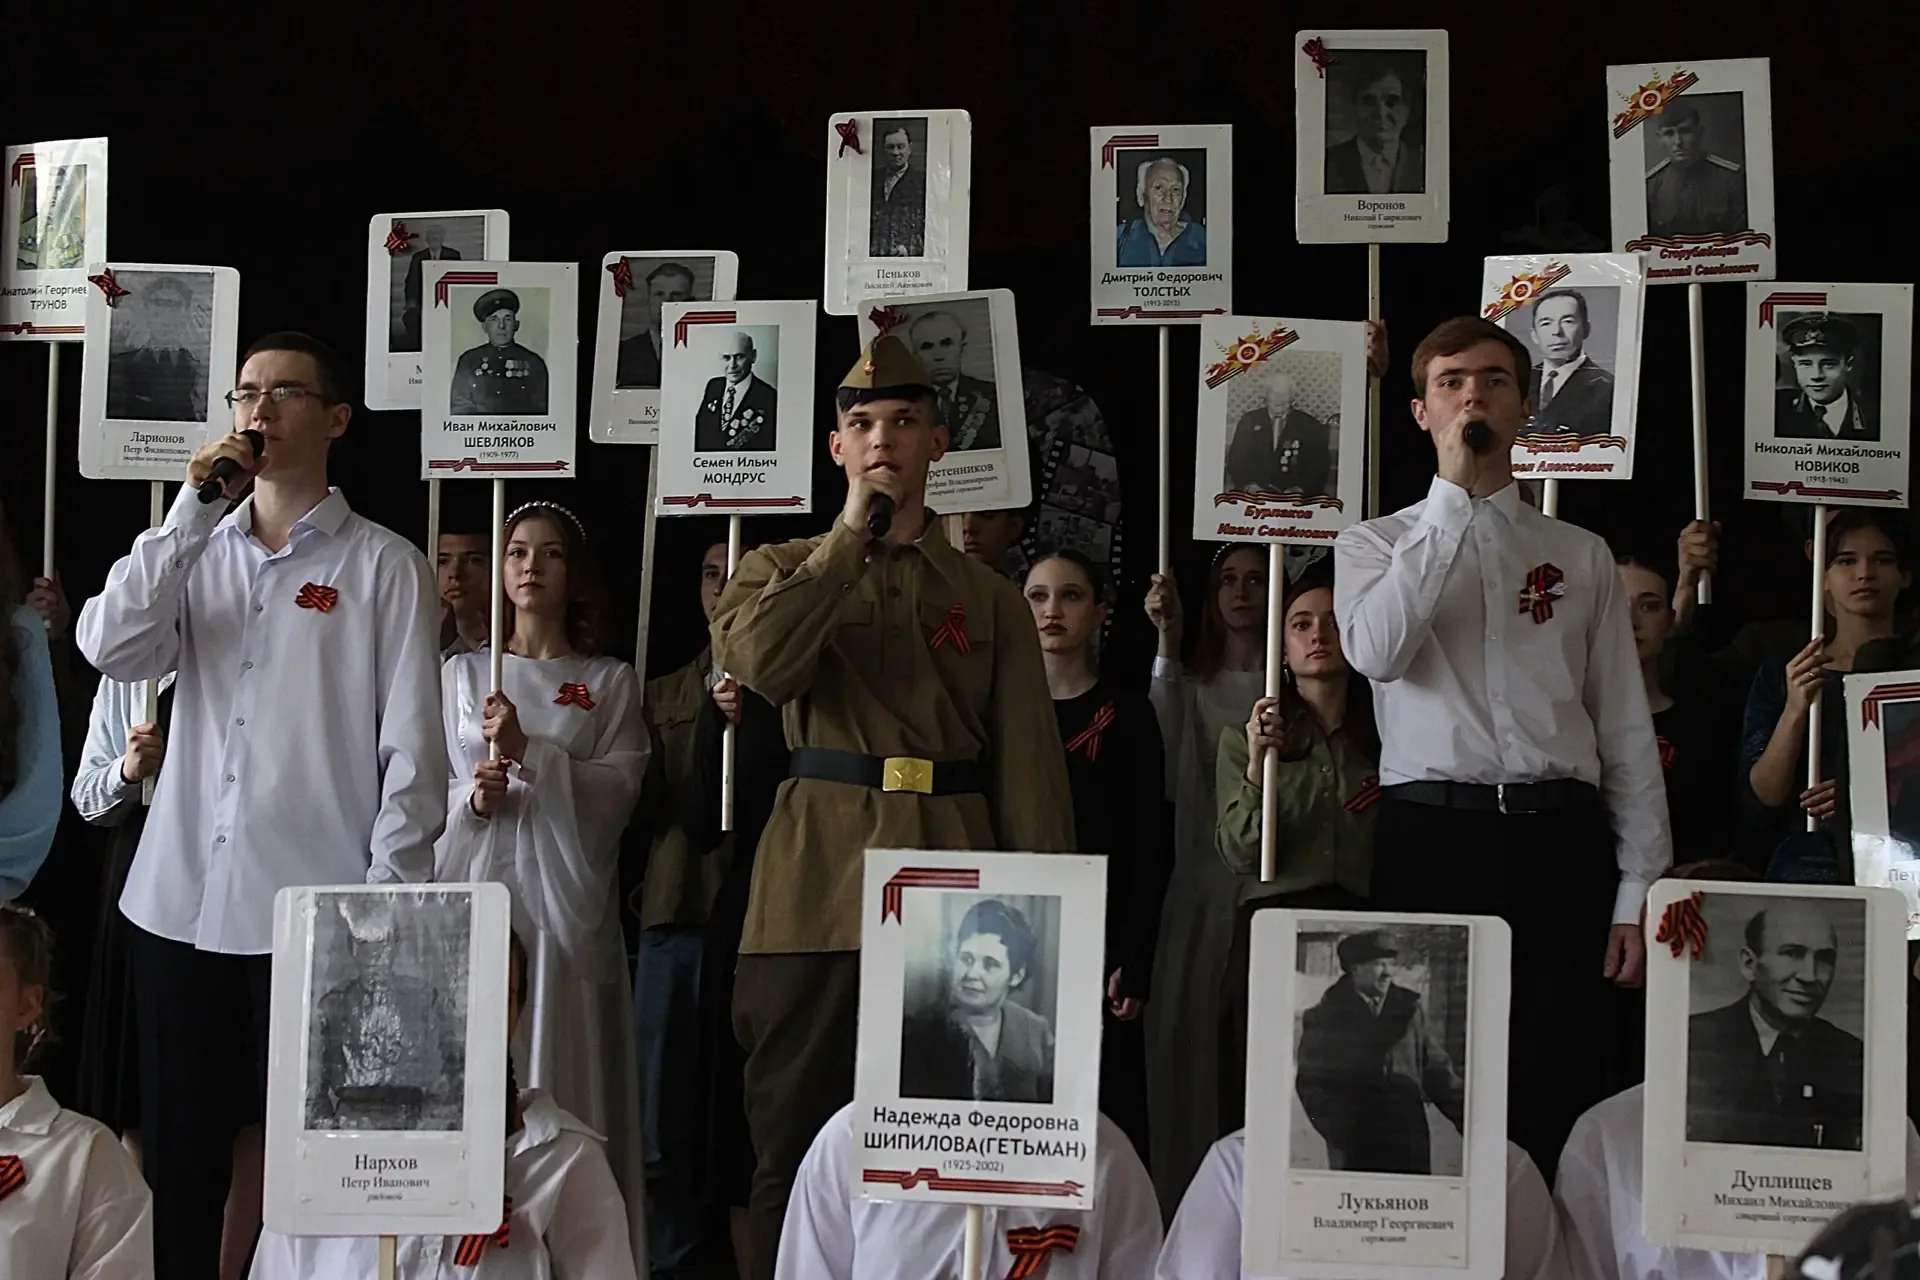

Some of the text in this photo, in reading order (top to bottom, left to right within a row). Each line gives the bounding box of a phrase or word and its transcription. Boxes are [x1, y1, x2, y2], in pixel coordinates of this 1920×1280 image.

[1357, 199, 1406, 212] Воронов
[877, 269, 921, 279] Пеньков
[1101, 271, 1223, 285] Дмитрий Федорович
[1, 285, 43, 297] Анатолий
[1133, 286, 1191, 297] ТОЛСТЫХ
[30, 299, 68, 310] ТРУНОВ
[443, 420, 556, 432] Иван Михайлович
[130, 431, 185, 445] Ларионов
[464, 436, 535, 448] ШЕВЛЯКОВ
[1754, 442, 1901, 459] Николай Михайлович
[693, 457, 777, 468] Семен Ильич
[1794, 460, 1860, 474] НОВИКОВ
[703, 472, 766, 486] МОНДРУС
[1217, 523, 1255, 535] Иван
[873, 1106, 1080, 1133] Надежда Федоровна
[863, 1132, 1087, 1165] ШИПИЛОВА(ГЕТЬМАН)
[354, 1154, 418, 1175] Нархов
[942, 1159, 1005, 1173] (1925-2002)
[341, 1177, 431, 1190] Петр Иванович
[1731, 1170, 1833, 1192] Дуплищев
[1337, 1192, 1430, 1214] Лукьянов
[1313, 1216, 1379, 1232] Владимир
